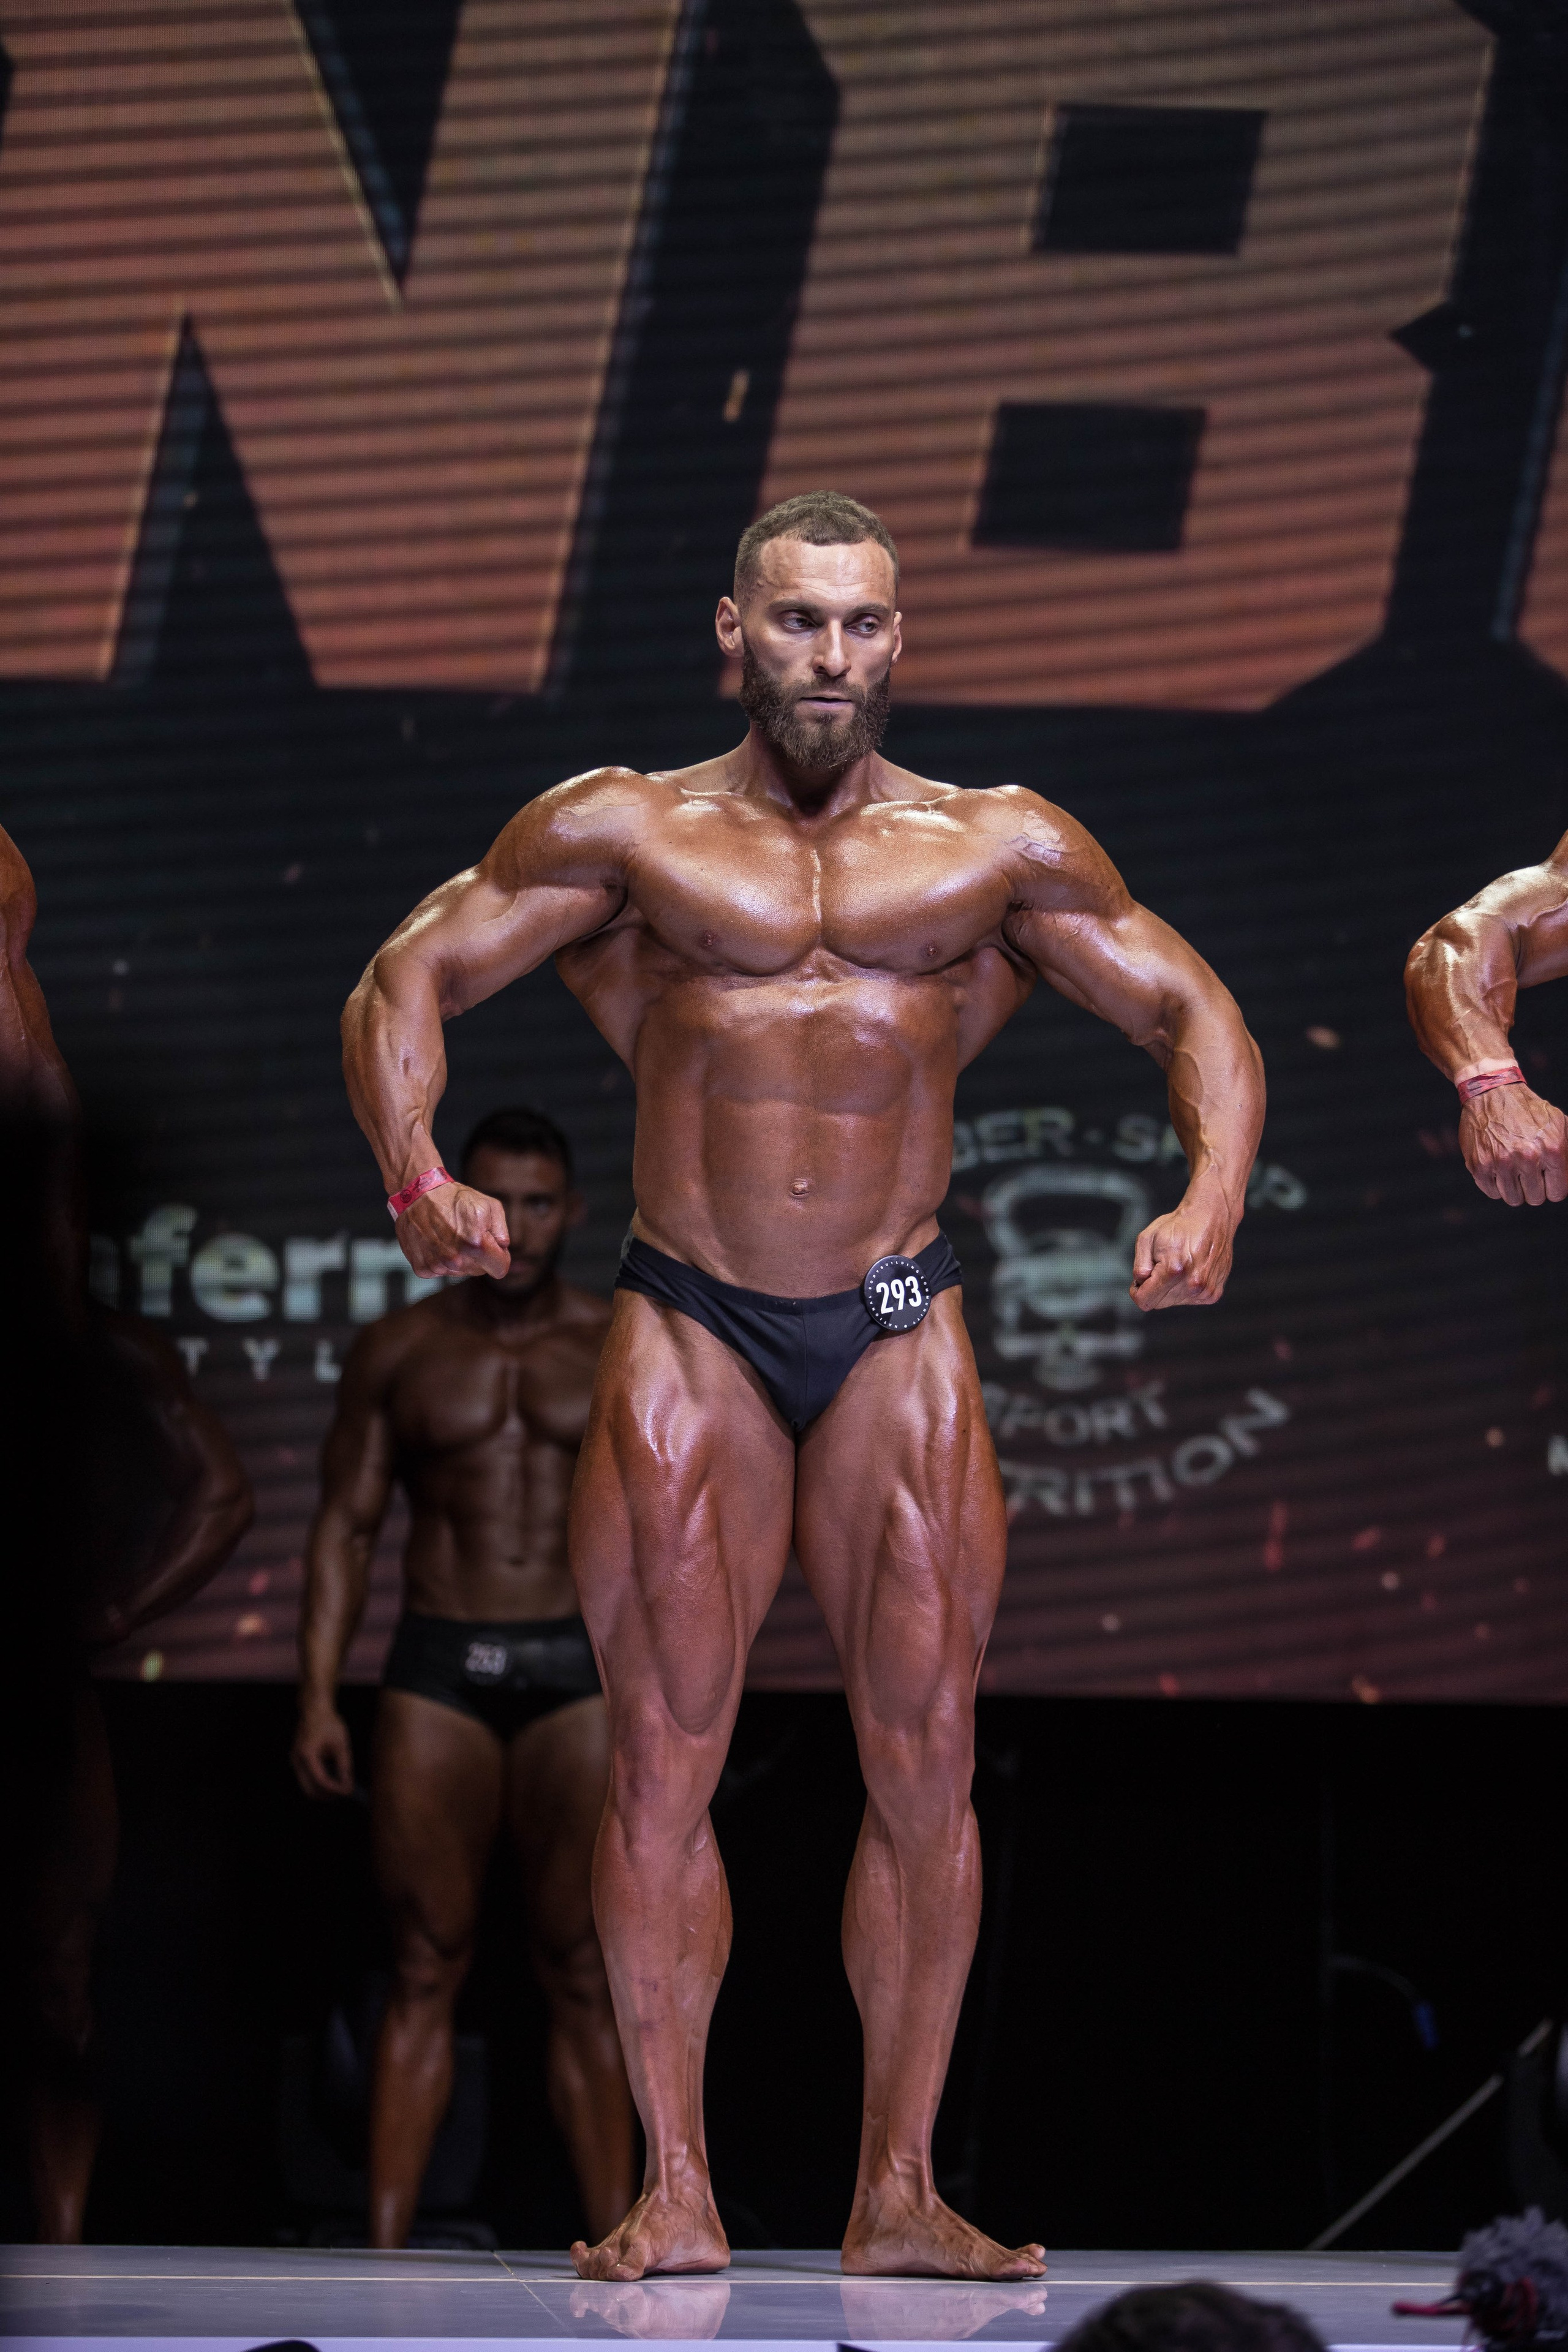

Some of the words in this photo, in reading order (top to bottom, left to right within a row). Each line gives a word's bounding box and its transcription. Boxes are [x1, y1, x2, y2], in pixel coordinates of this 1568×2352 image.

[0, 0, 1568, 714] NB
[868, 1261, 920, 1291] BODYBUILDING
[876, 1276, 922, 1314] 293
[868, 1295, 899, 1329] NATIONAL
[912, 1275, 930, 1325] COMMUNITY
